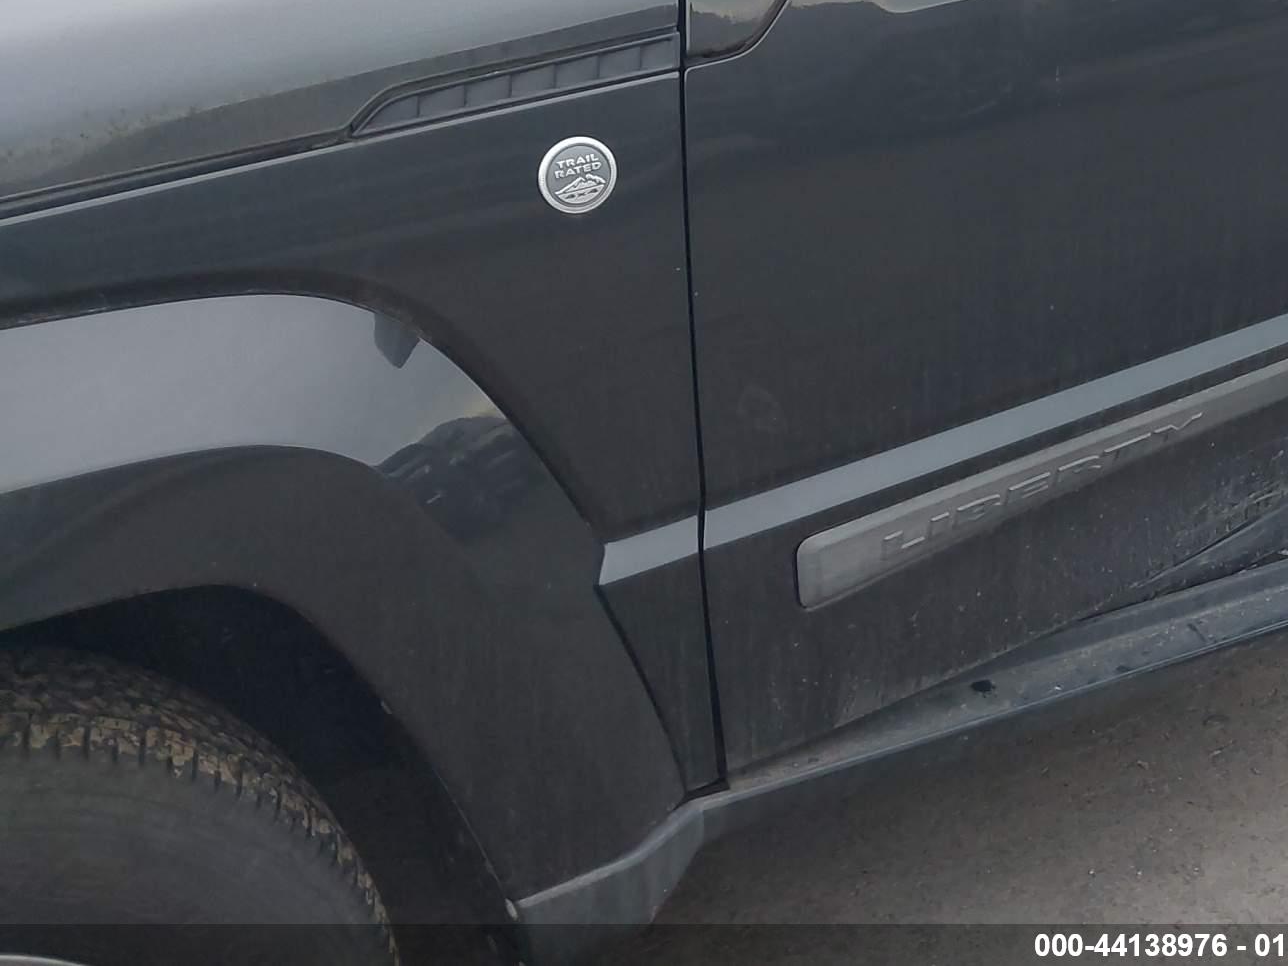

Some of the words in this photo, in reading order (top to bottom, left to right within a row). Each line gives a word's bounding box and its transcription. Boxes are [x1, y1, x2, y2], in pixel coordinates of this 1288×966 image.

[554, 161, 602, 179] RATED
[555, 153, 599, 169] TRAIL
[879, 411, 1204, 558] LIBERTY
